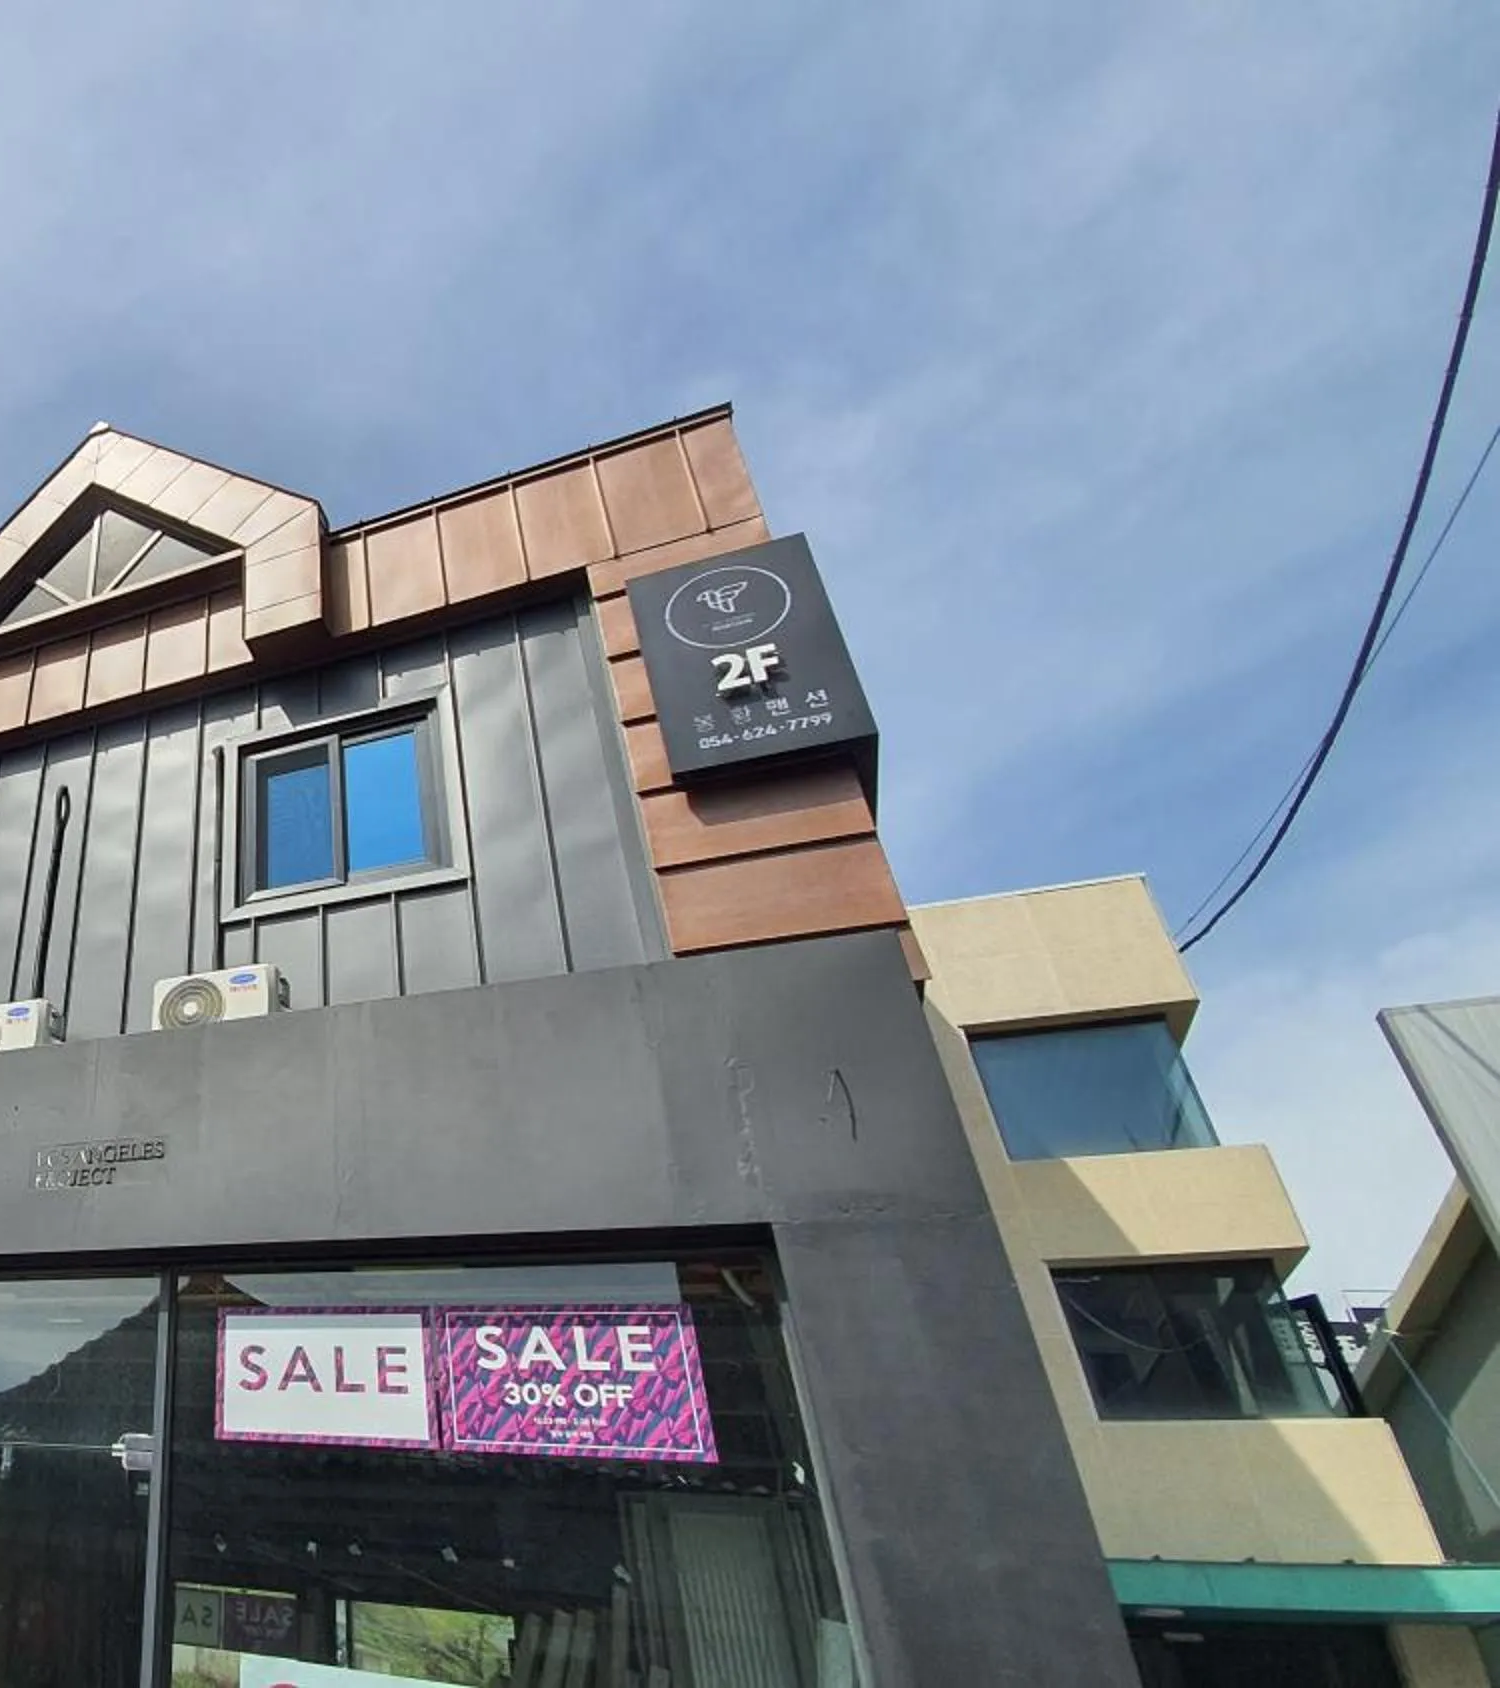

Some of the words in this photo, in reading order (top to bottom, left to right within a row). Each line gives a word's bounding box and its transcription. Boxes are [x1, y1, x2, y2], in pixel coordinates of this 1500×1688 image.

[711, 643, 779, 691] 2F
[698, 712, 832, 749] 054-624-7799
[239, 1345, 409, 1394] SALE
[475, 1325, 657, 1371] SALE
[503, 1382, 566, 1407] 30%
[574, 1383, 633, 1408] OFF
